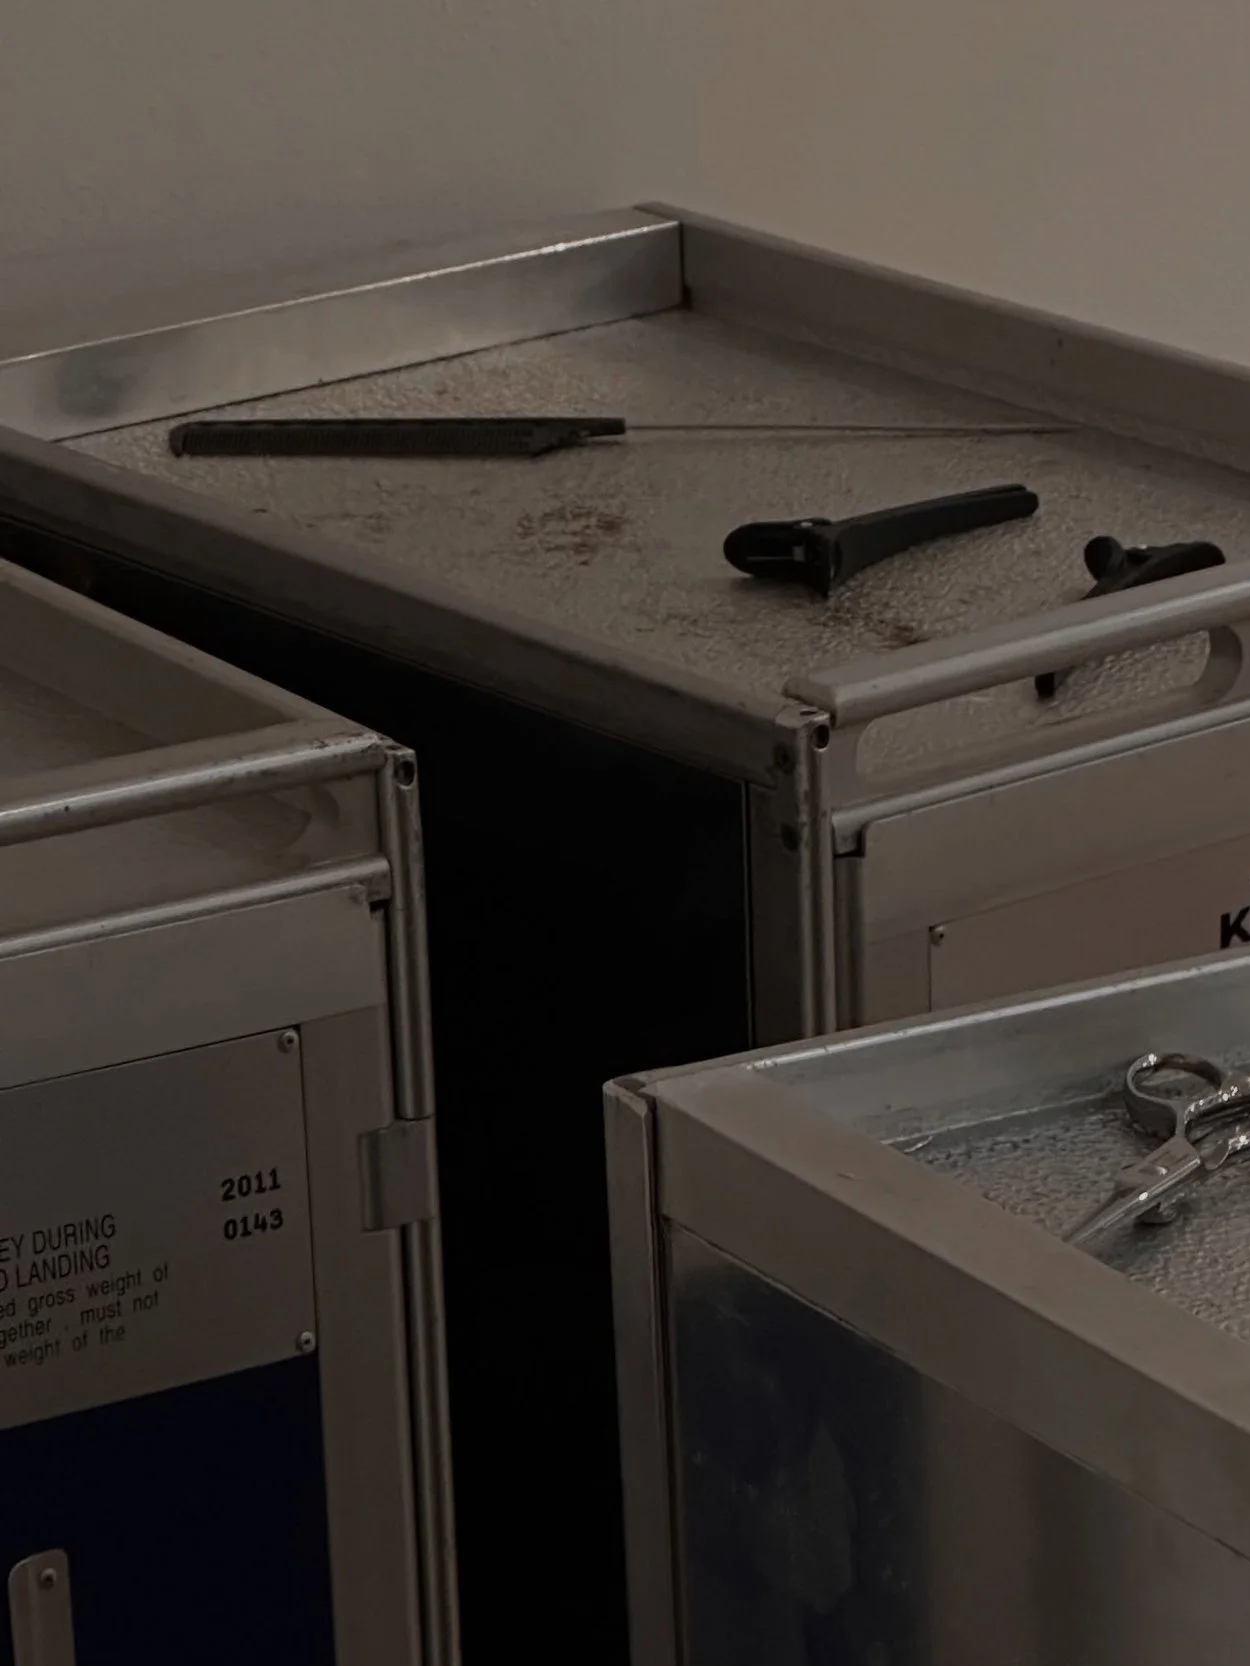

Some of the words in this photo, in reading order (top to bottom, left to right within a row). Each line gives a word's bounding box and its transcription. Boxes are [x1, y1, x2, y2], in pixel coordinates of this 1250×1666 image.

[221, 1168, 281, 1201] 2011
[33, 1214, 116, 1255] DURING
[223, 1208, 284, 1240] 0143
[16, 1244, 110, 1288] LANDING
[28, 1288, 75, 1317] gross
[86, 1270, 141, 1297] weight
[152, 1262, 168, 1283] of
[80, 1301, 123, 1325] must
[132, 1291, 159, 1312] not
[5, 1338, 61, 1368] weight
[72, 1332, 88, 1352] of
[100, 1325, 126, 1345] the
